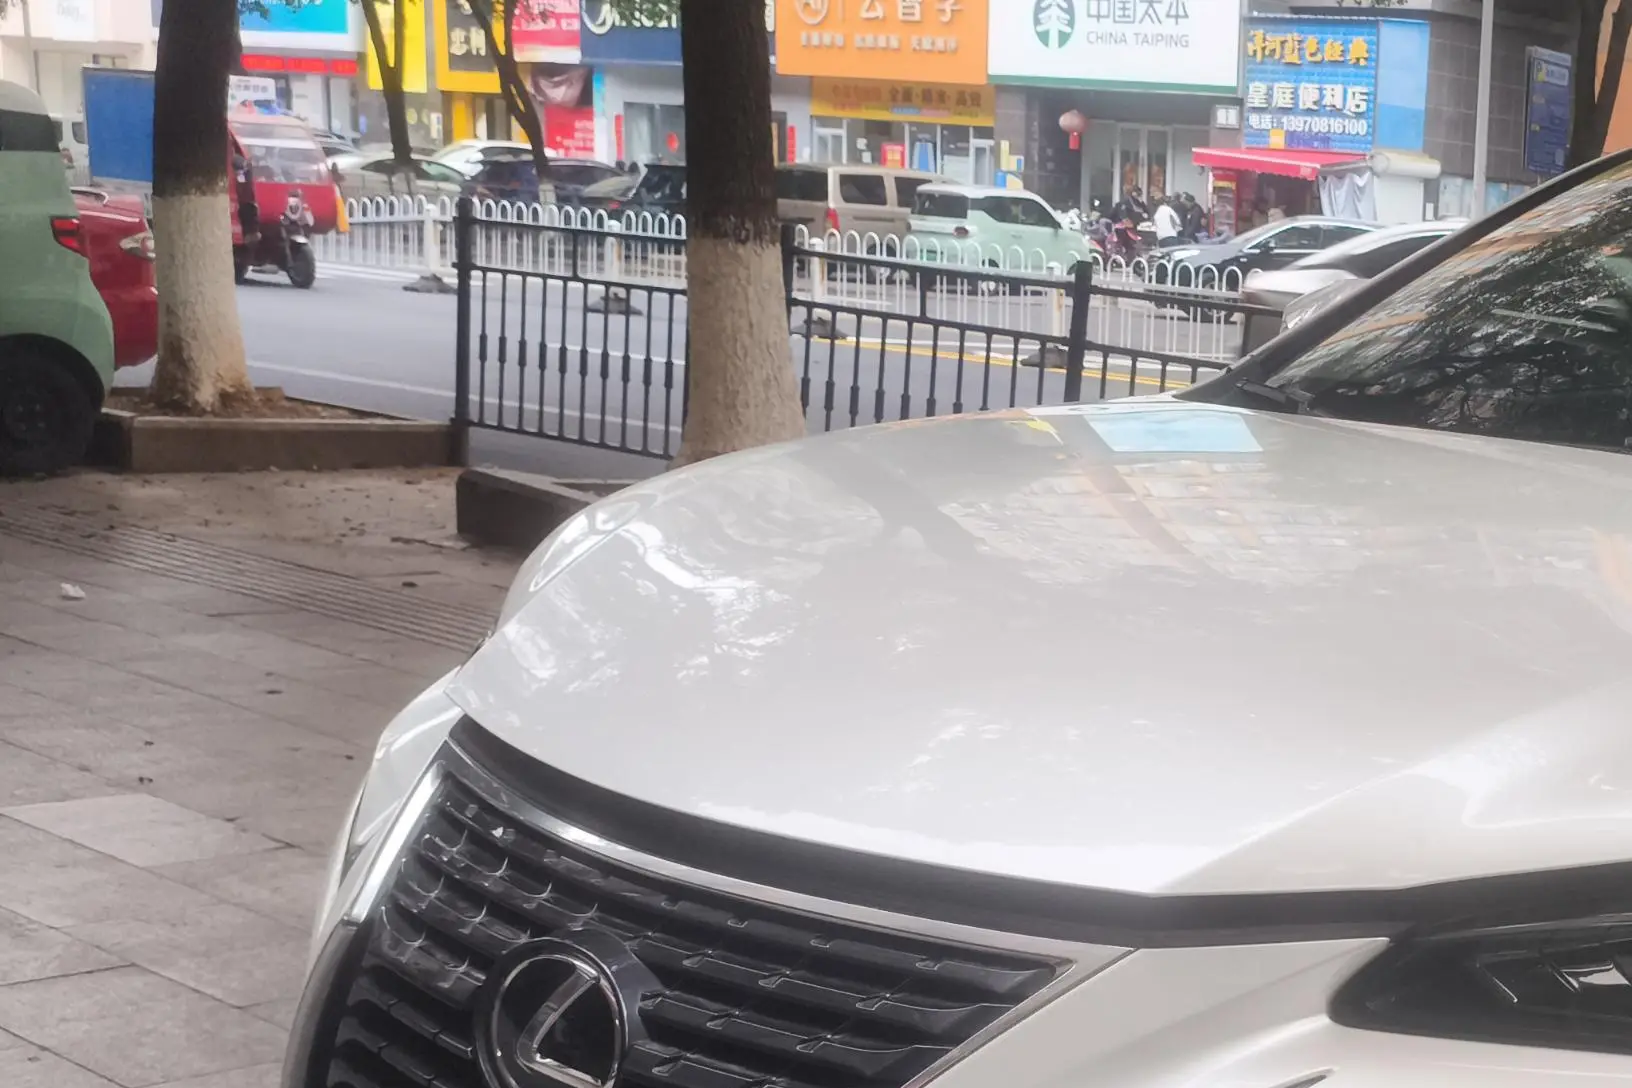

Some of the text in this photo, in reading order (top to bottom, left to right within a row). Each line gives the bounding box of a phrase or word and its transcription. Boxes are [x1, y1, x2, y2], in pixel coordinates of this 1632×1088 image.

[1086, 31, 1190, 48] CHINA TAIPING
[1247, 81, 1369, 115] 皇庭便利店
